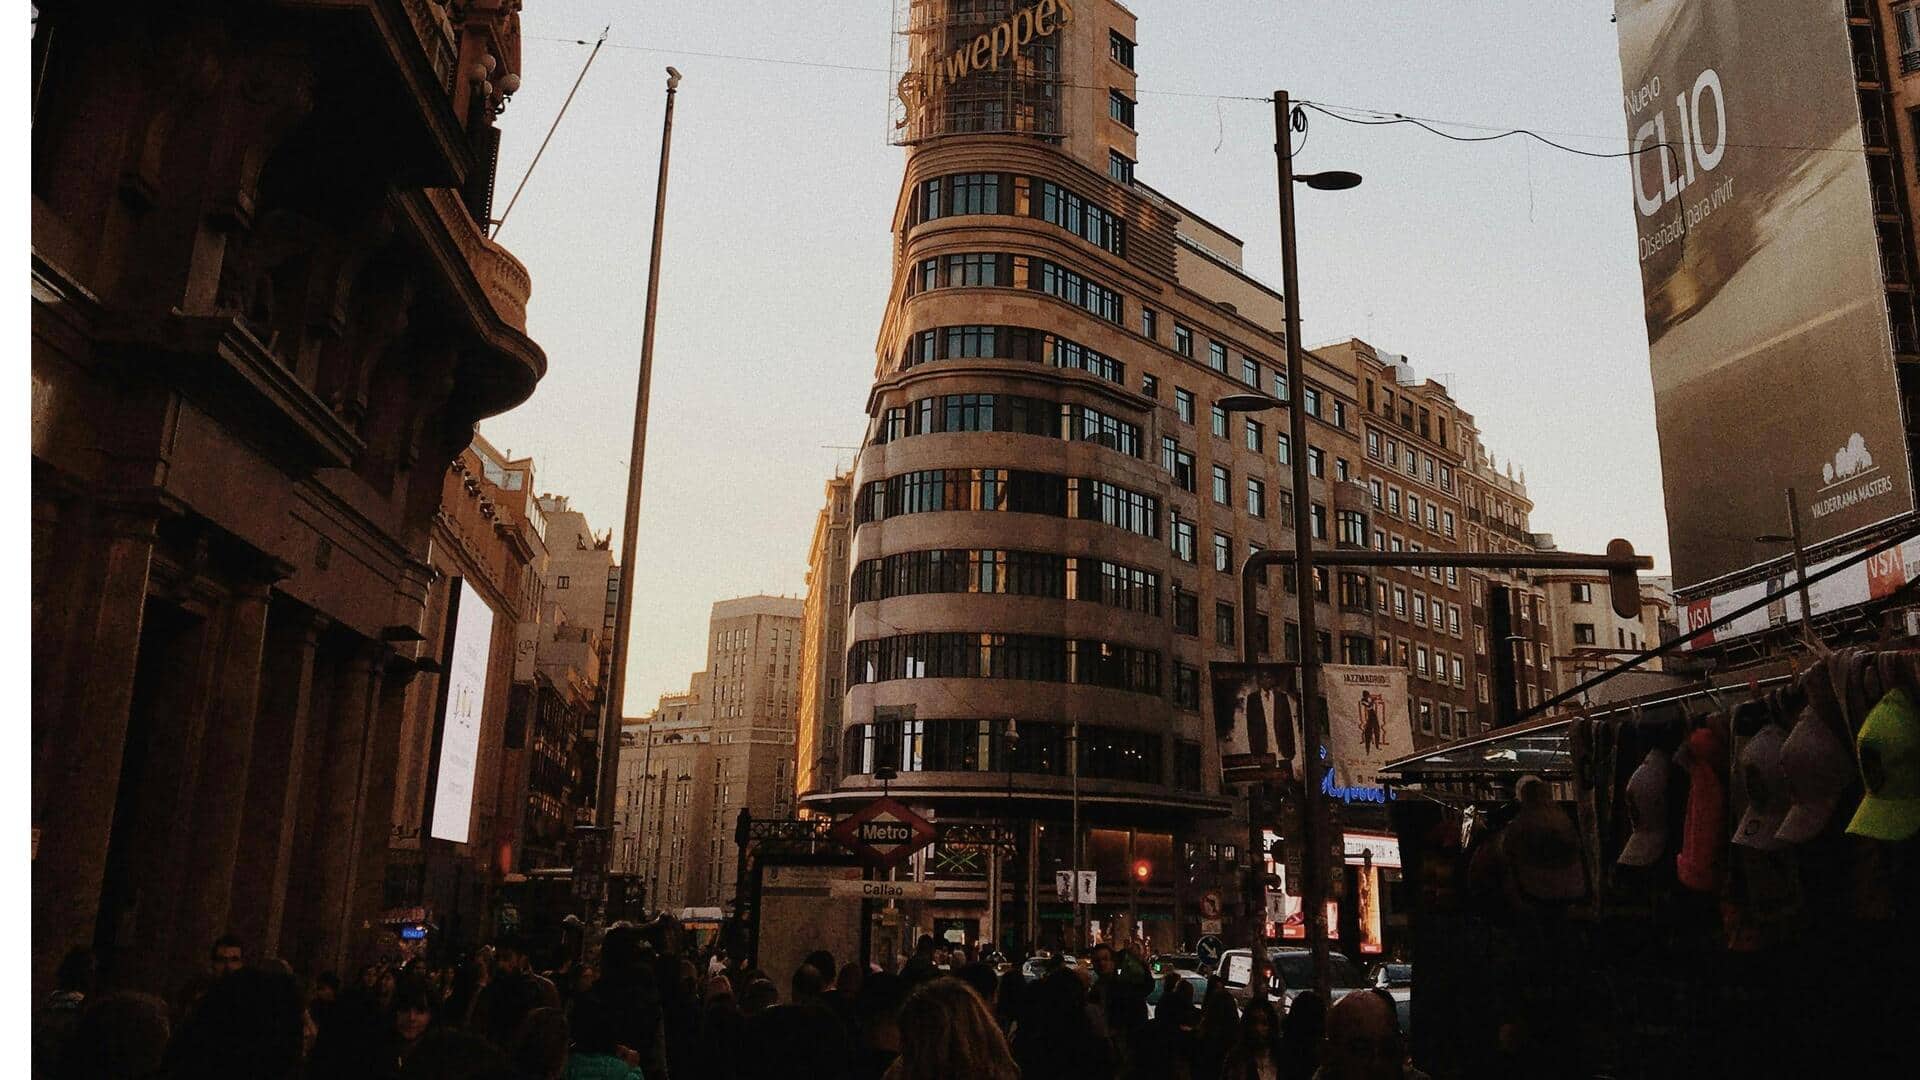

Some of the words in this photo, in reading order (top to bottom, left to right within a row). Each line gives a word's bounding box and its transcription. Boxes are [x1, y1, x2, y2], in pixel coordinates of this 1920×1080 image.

[895, 0, 1074, 130] Shweppes
[1624, 75, 1660, 119] Nuevo
[1633, 68, 1727, 217] CLIO
[1686, 198, 1711, 235] para
[1710, 175, 1735, 209] vivir
[1811, 489, 1858, 519] VALDERRAMA
[1857, 475, 1893, 503] MASTERS
[863, 824, 909, 840] Metro
[863, 884, 904, 896] Callao
